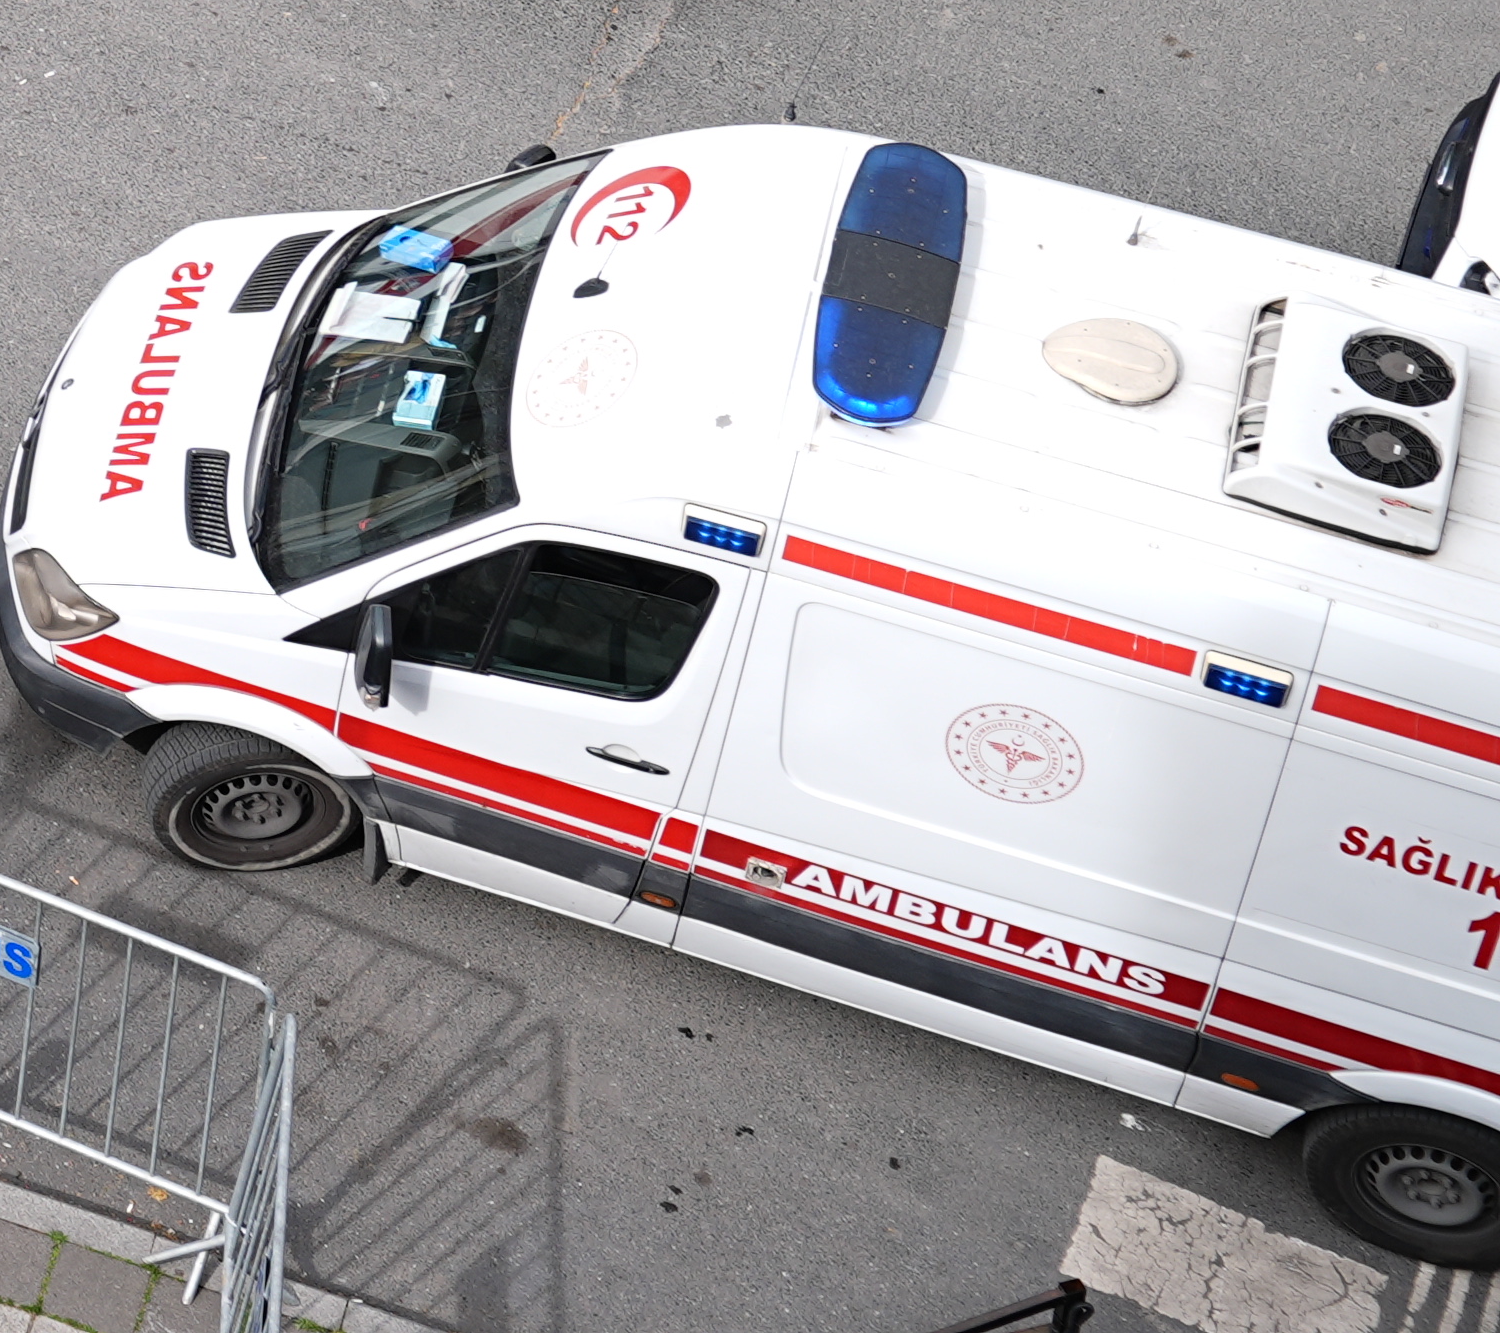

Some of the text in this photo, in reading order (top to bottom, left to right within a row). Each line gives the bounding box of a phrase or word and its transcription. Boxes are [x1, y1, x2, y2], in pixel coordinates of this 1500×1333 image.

[595, 186, 654, 245] 112
[1340, 825, 1500, 900] SAĞLIK
[791, 864, 1167, 996] AMBULANS
